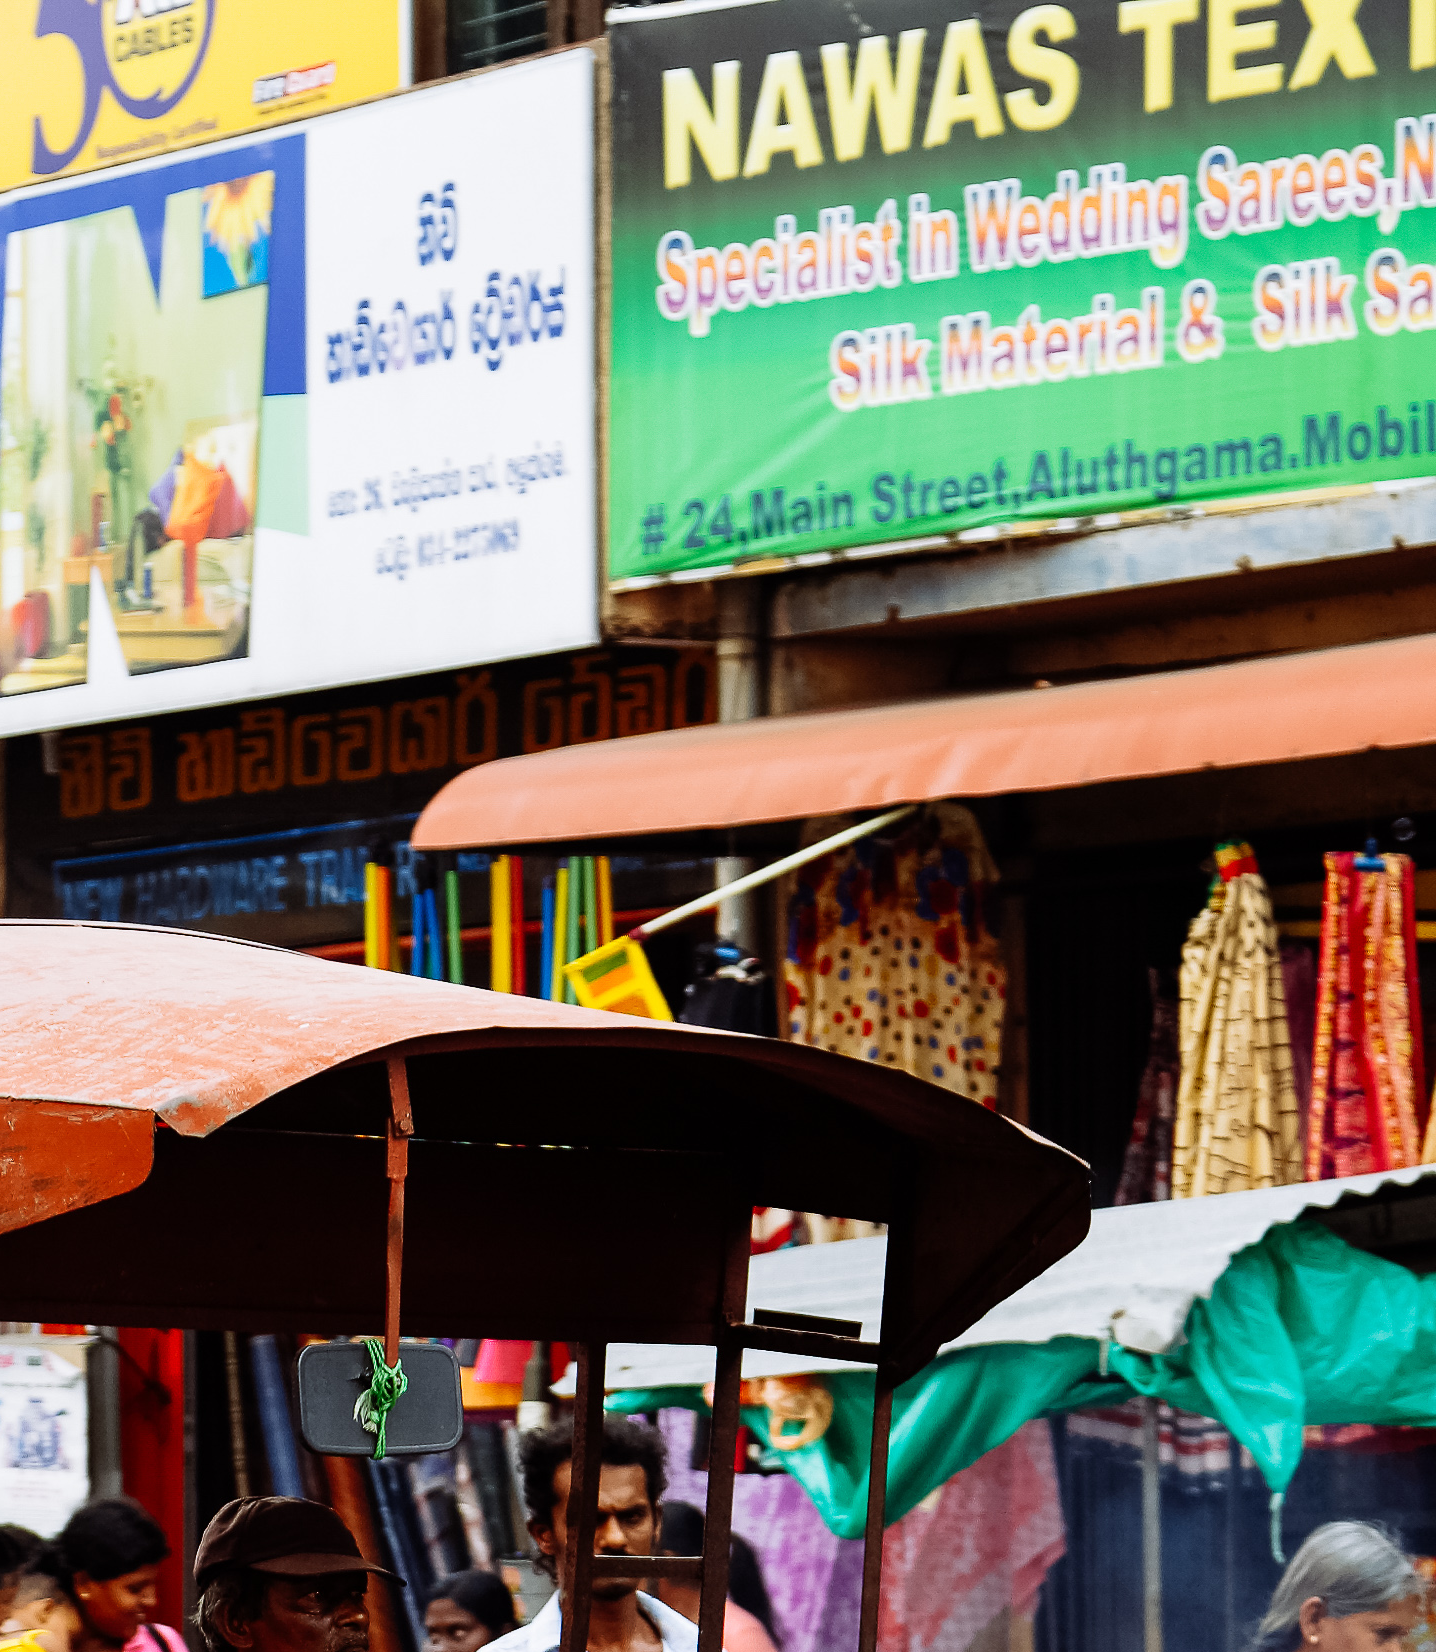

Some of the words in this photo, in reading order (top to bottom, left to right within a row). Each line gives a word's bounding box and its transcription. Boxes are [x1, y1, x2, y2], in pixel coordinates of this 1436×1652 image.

[662, 4, 1080, 190] NAWAS
[656, 199, 901, 336] Specialist
[908, 193, 959, 284] in
[965, 162, 1189, 269] Wedding
[829, 322, 932, 412] Silk
[940, 286, 1165, 396] Material
[1175, 278, 1223, 362] &
[1252, 256, 1358, 351] Silk
[641, 506, 665, 556] #
